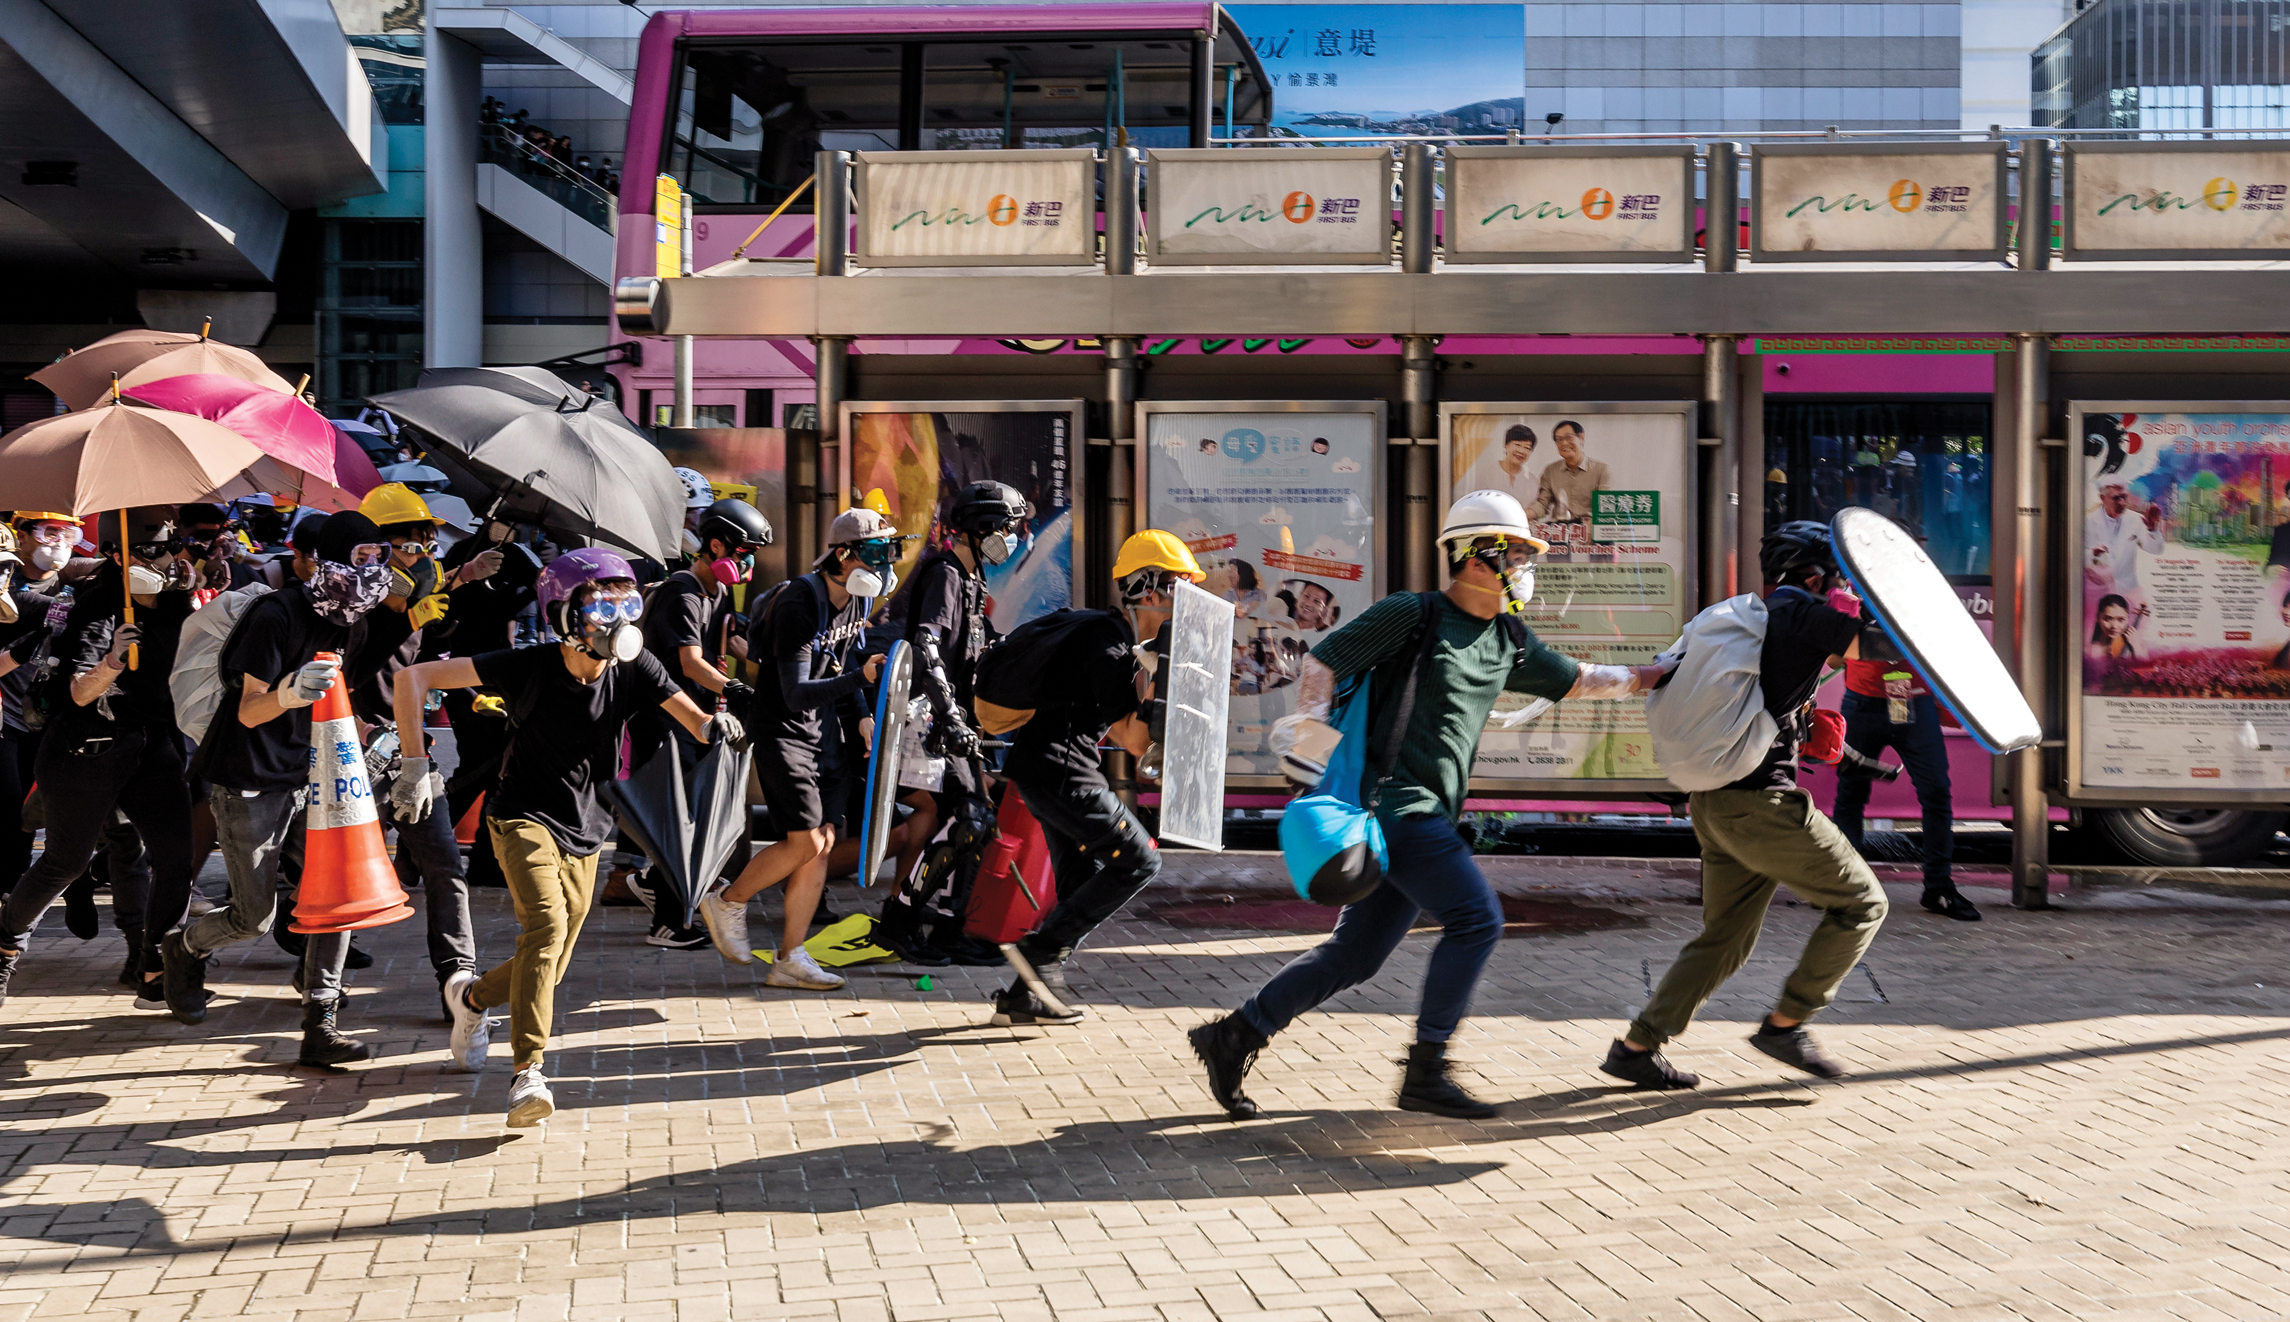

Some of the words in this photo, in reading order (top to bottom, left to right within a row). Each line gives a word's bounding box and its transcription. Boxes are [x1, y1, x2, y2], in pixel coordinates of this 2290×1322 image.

[1313, 27, 1378, 58] 意堤
[1288, 72, 1339, 88] 愉景灣
[1927, 186, 1971, 203] 新巴
[2243, 184, 2288, 202] 新巴
[1023, 201, 1063, 218] 新巴
[1319, 198, 1361, 215] 新巴
[1619, 194, 1661, 211] 新巴
[2141, 421, 2187, 436] asian
[2190, 421, 2238, 439] youth
[1598, 493, 1653, 514] 醫療券
[1546, 544, 1568, 555] are
[1570, 544, 1615, 555] Voucher
[1617, 544, 1660, 555] Scheme
[1475, 755, 1521, 766] .hcv.gov.hk
